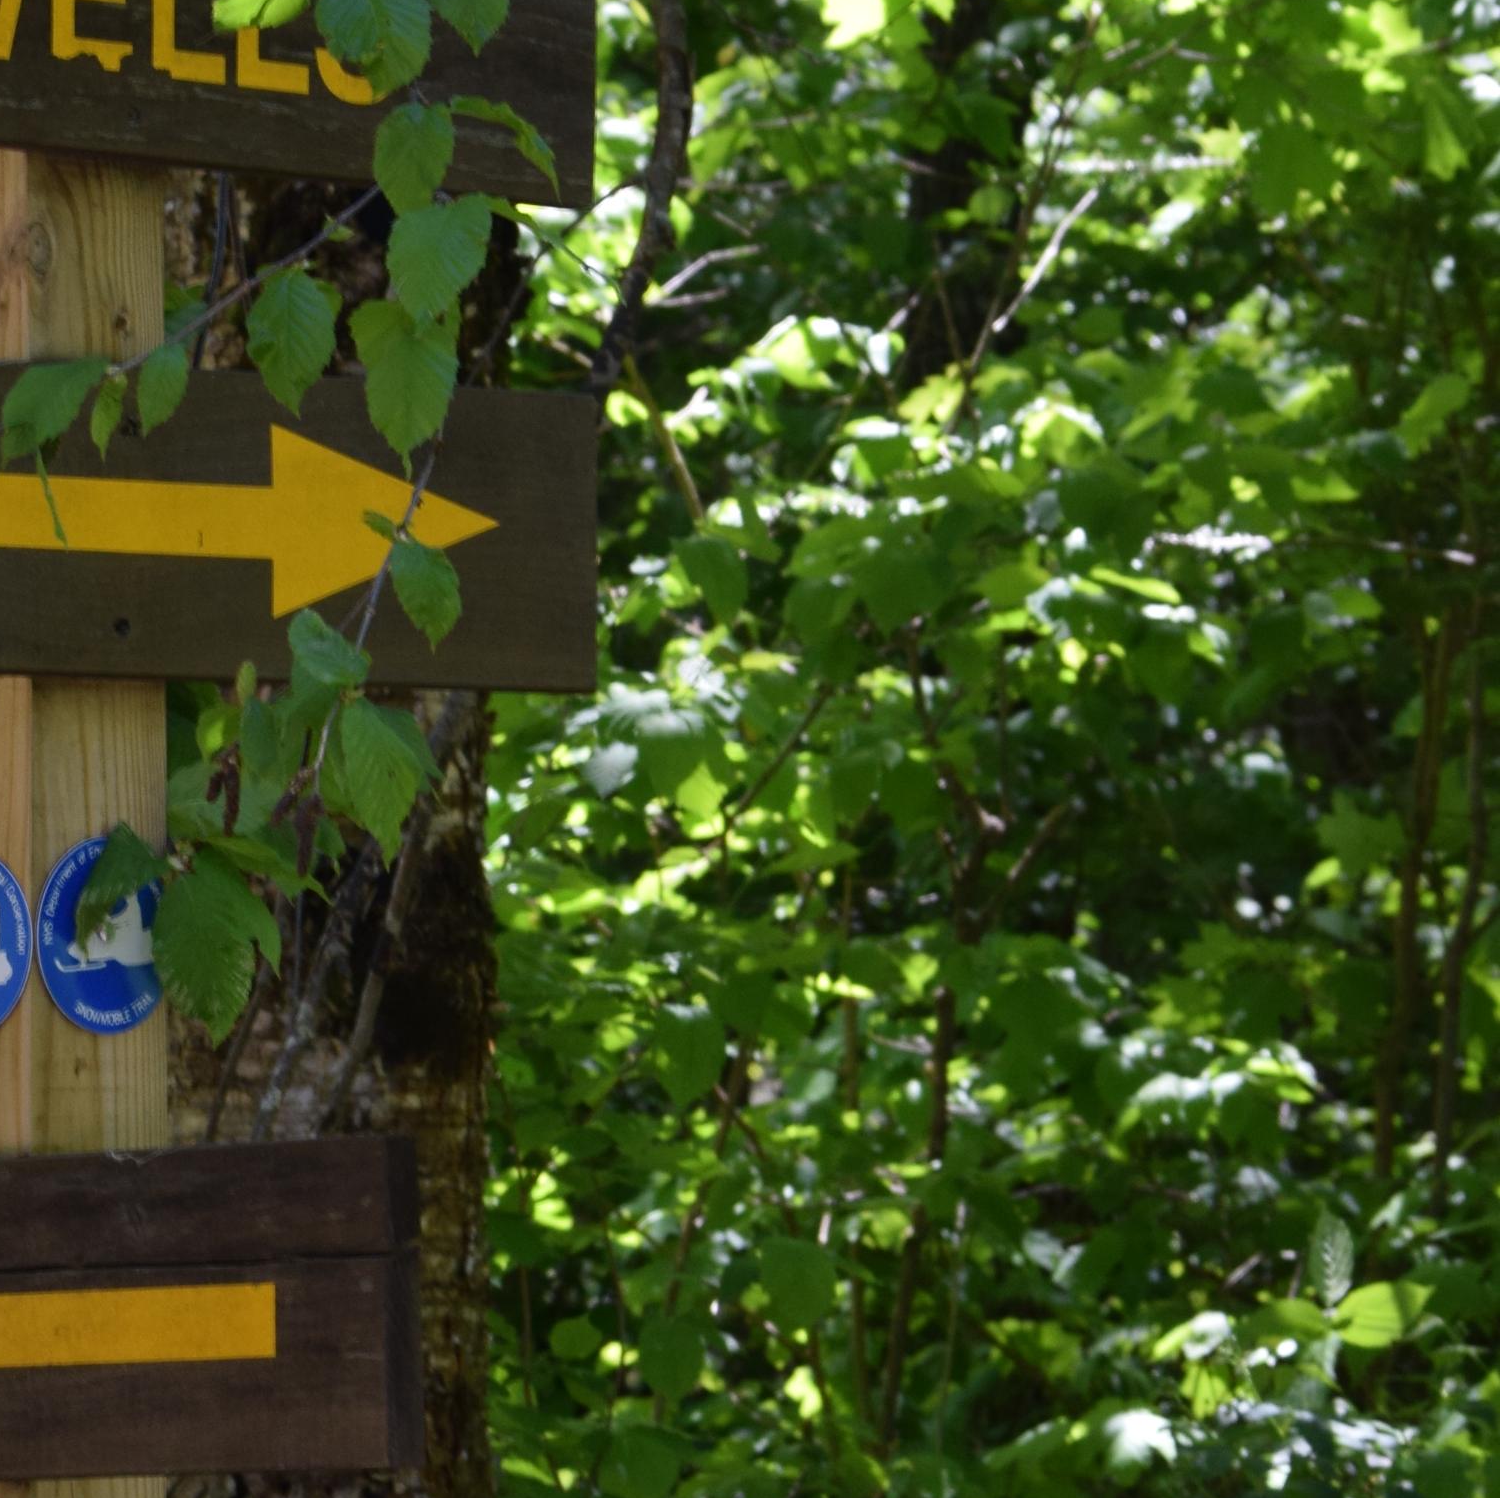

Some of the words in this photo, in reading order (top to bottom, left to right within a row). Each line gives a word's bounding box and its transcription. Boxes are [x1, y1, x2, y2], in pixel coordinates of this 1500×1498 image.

[44, 859, 77, 917] Department
[5, 883, 27, 956] Conservation
[74, 998, 132, 1028] SNOWMOBILE
[131, 993, 156, 1018] TRAIL
